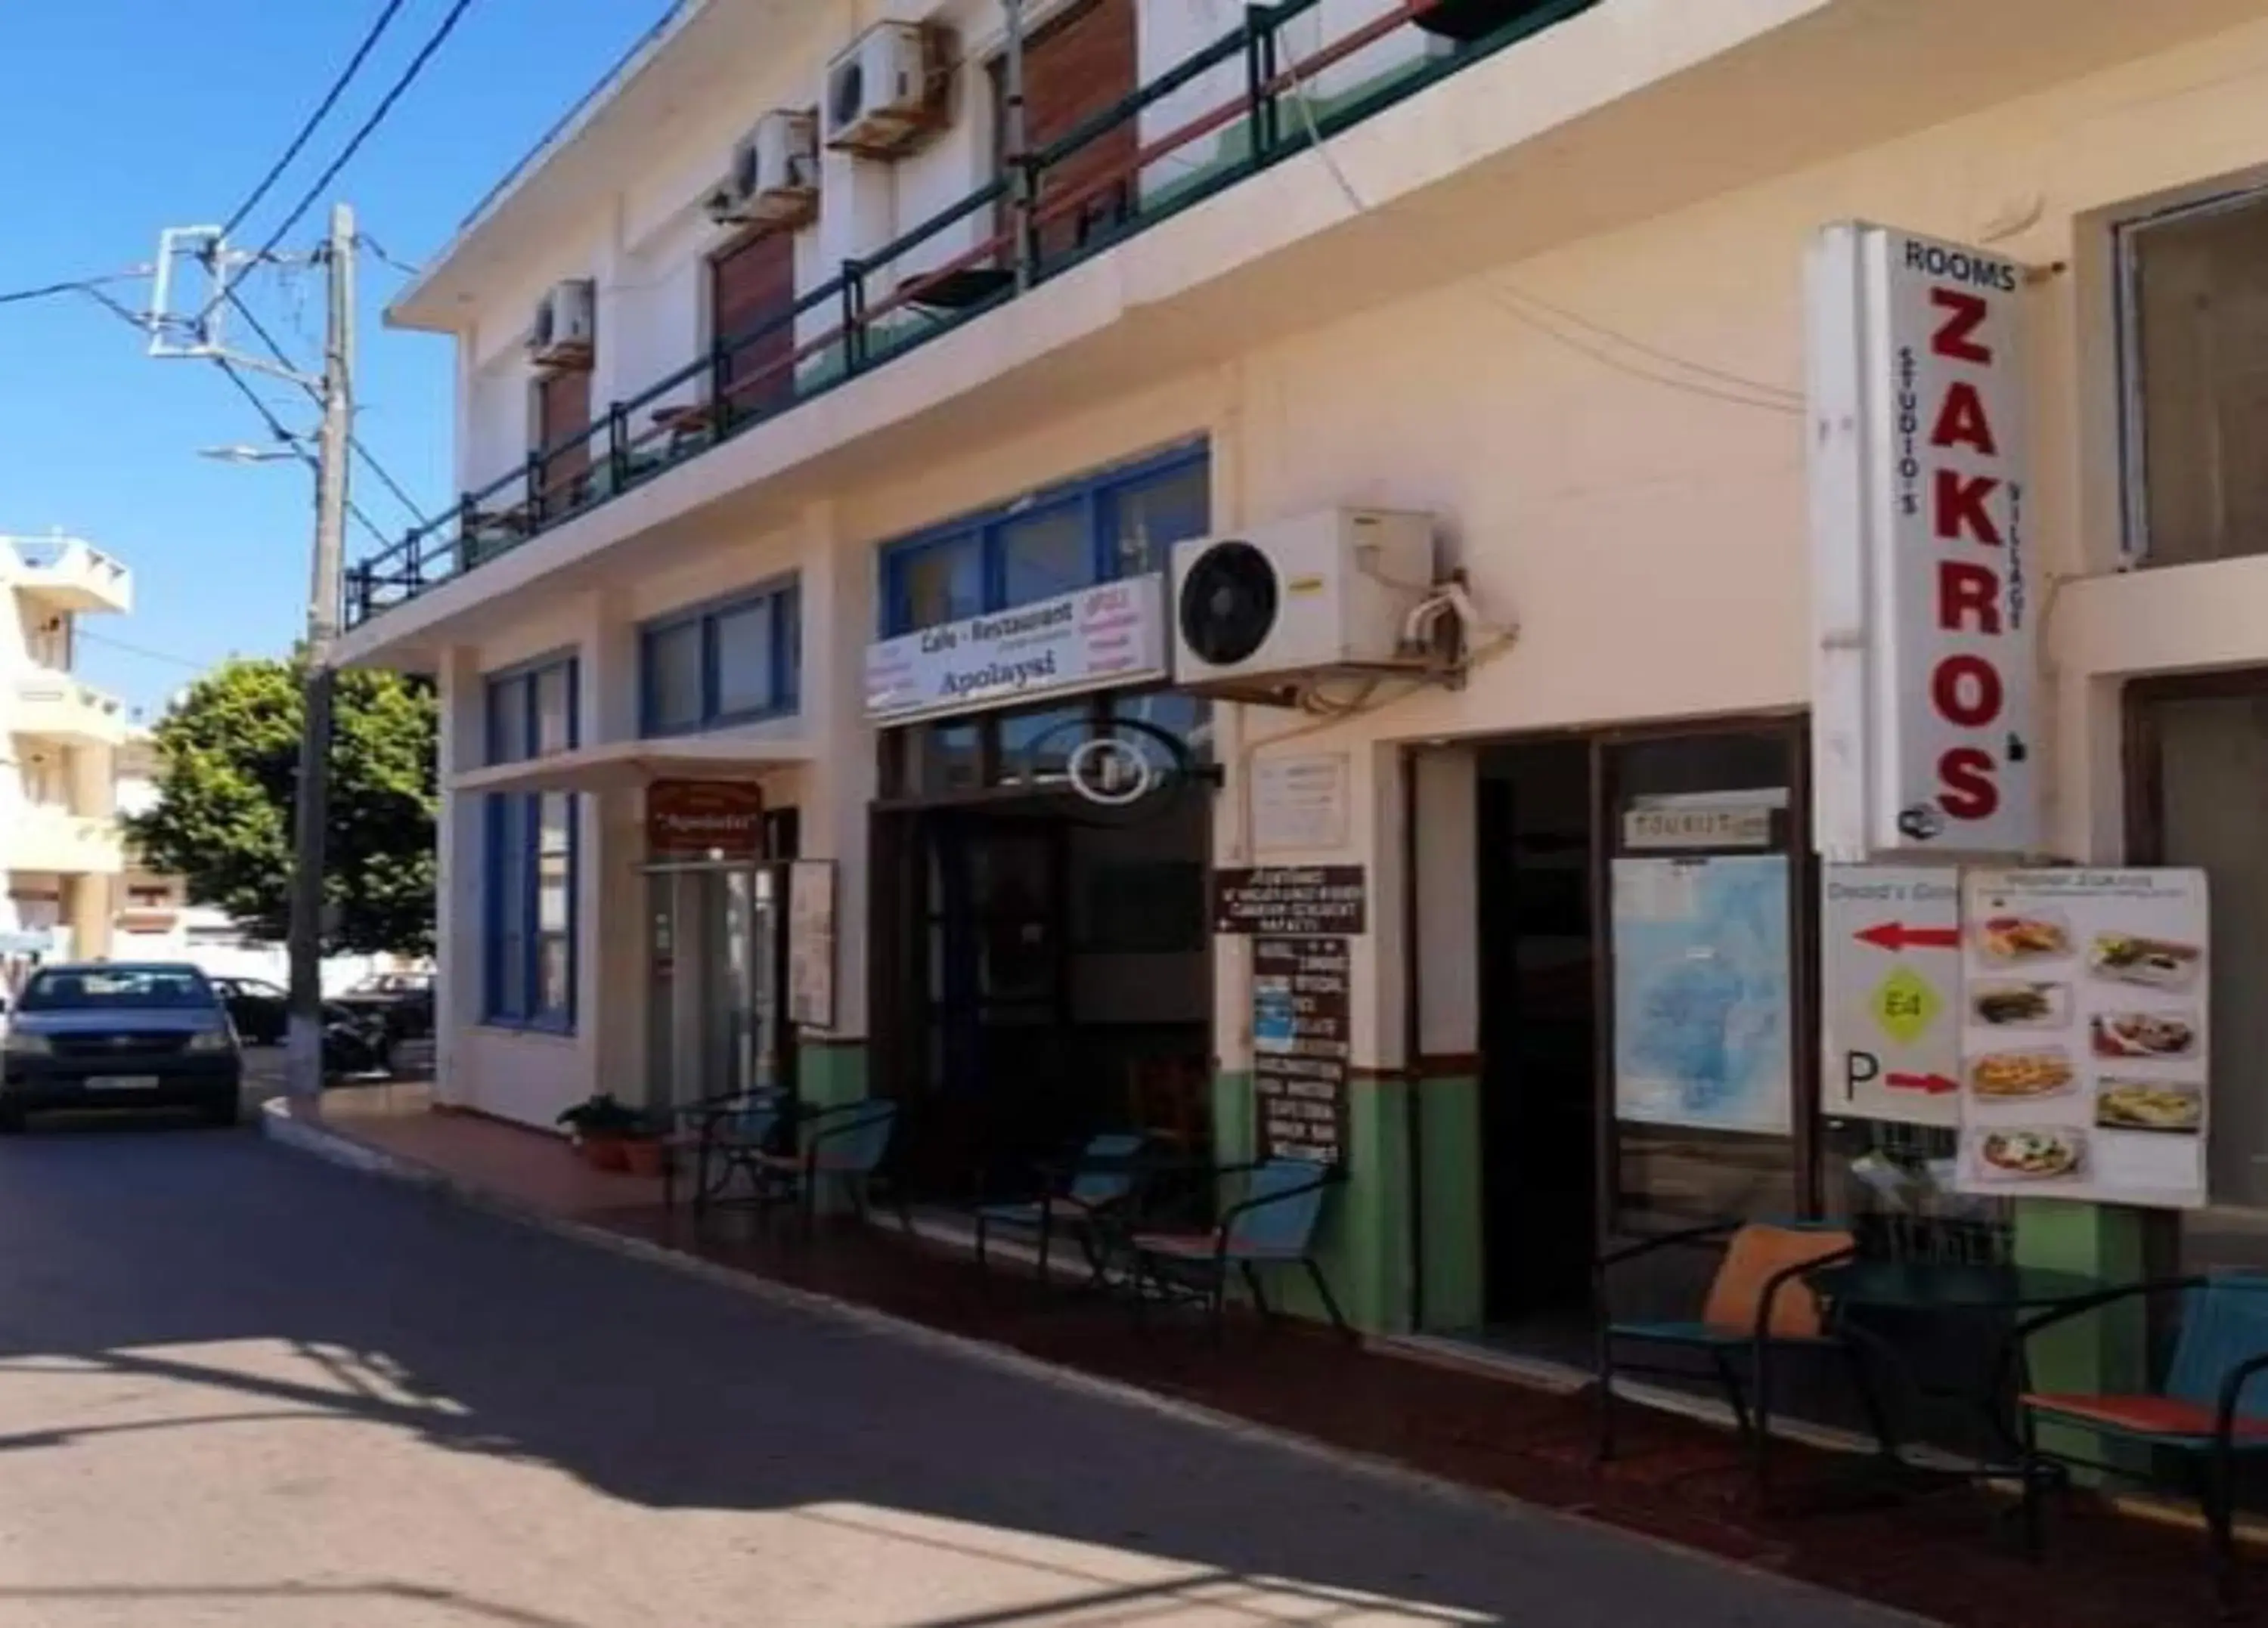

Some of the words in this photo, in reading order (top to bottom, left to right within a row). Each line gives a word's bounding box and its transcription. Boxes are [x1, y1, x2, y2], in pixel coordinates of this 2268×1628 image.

[1905, 239, 2016, 293] ROOMS
[1929, 286, 2004, 822] ZAKROS
[971, 604, 1074, 642] Restaurant
[1845, 1049, 1880, 1100] P
